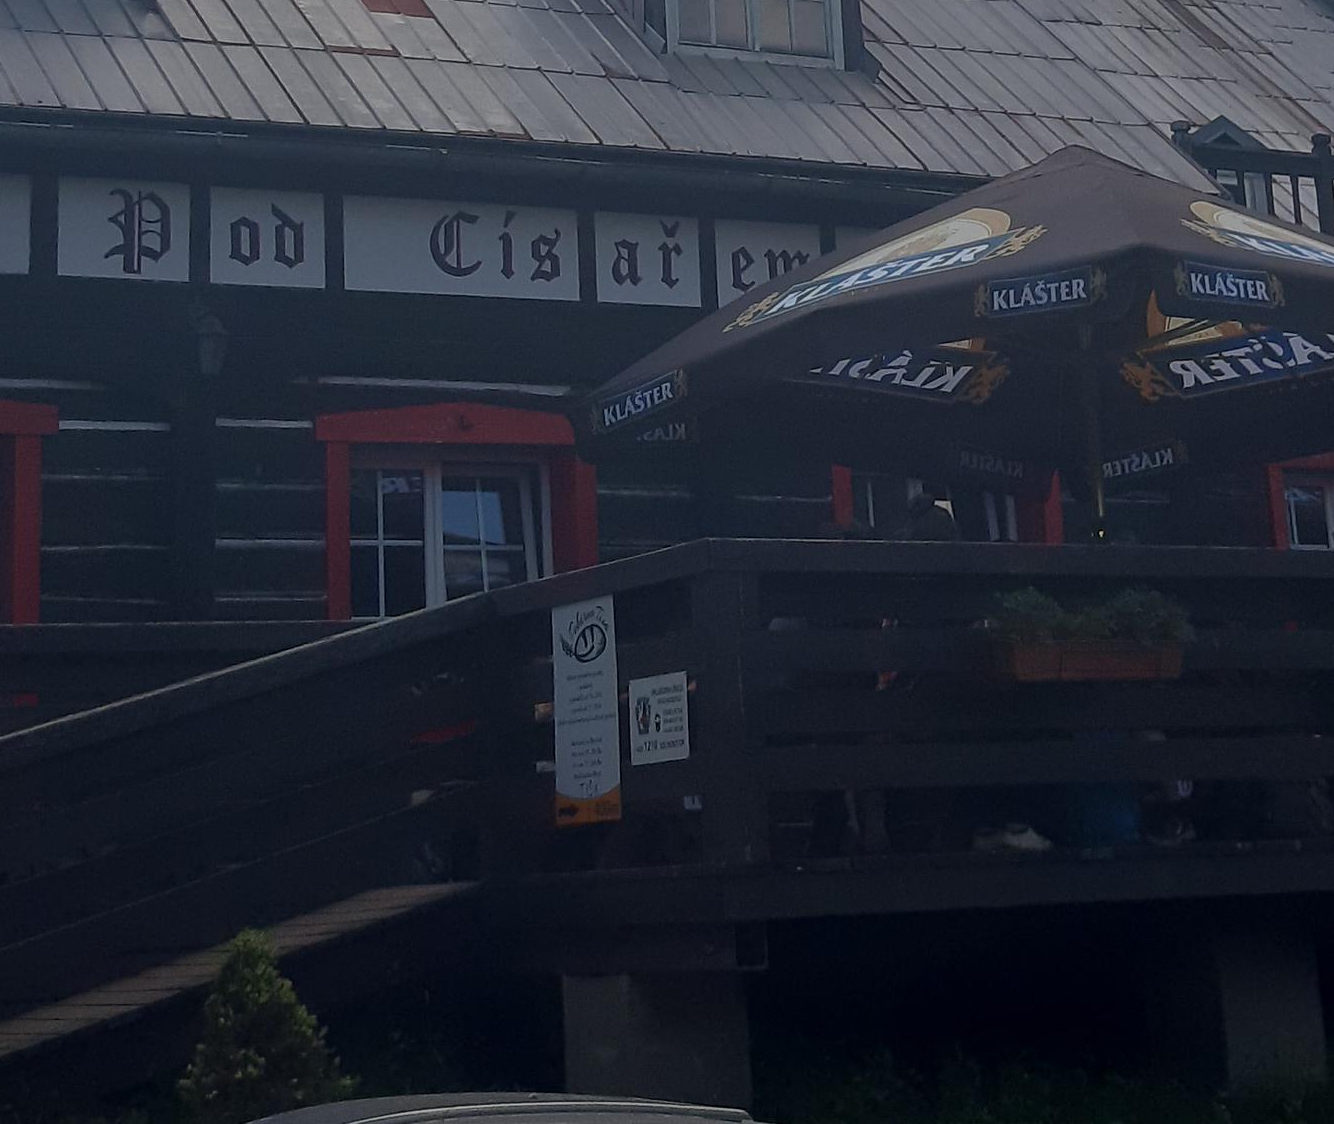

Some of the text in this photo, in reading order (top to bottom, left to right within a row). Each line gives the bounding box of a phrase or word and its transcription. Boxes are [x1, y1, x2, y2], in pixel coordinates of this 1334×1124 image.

[103, 188, 305, 274] Pod
[992, 276, 1088, 311] KLÁŠTER
[1190, 272, 1270, 301] KLÁŠTER
[603, 382, 674, 427] KLÁŠTER
